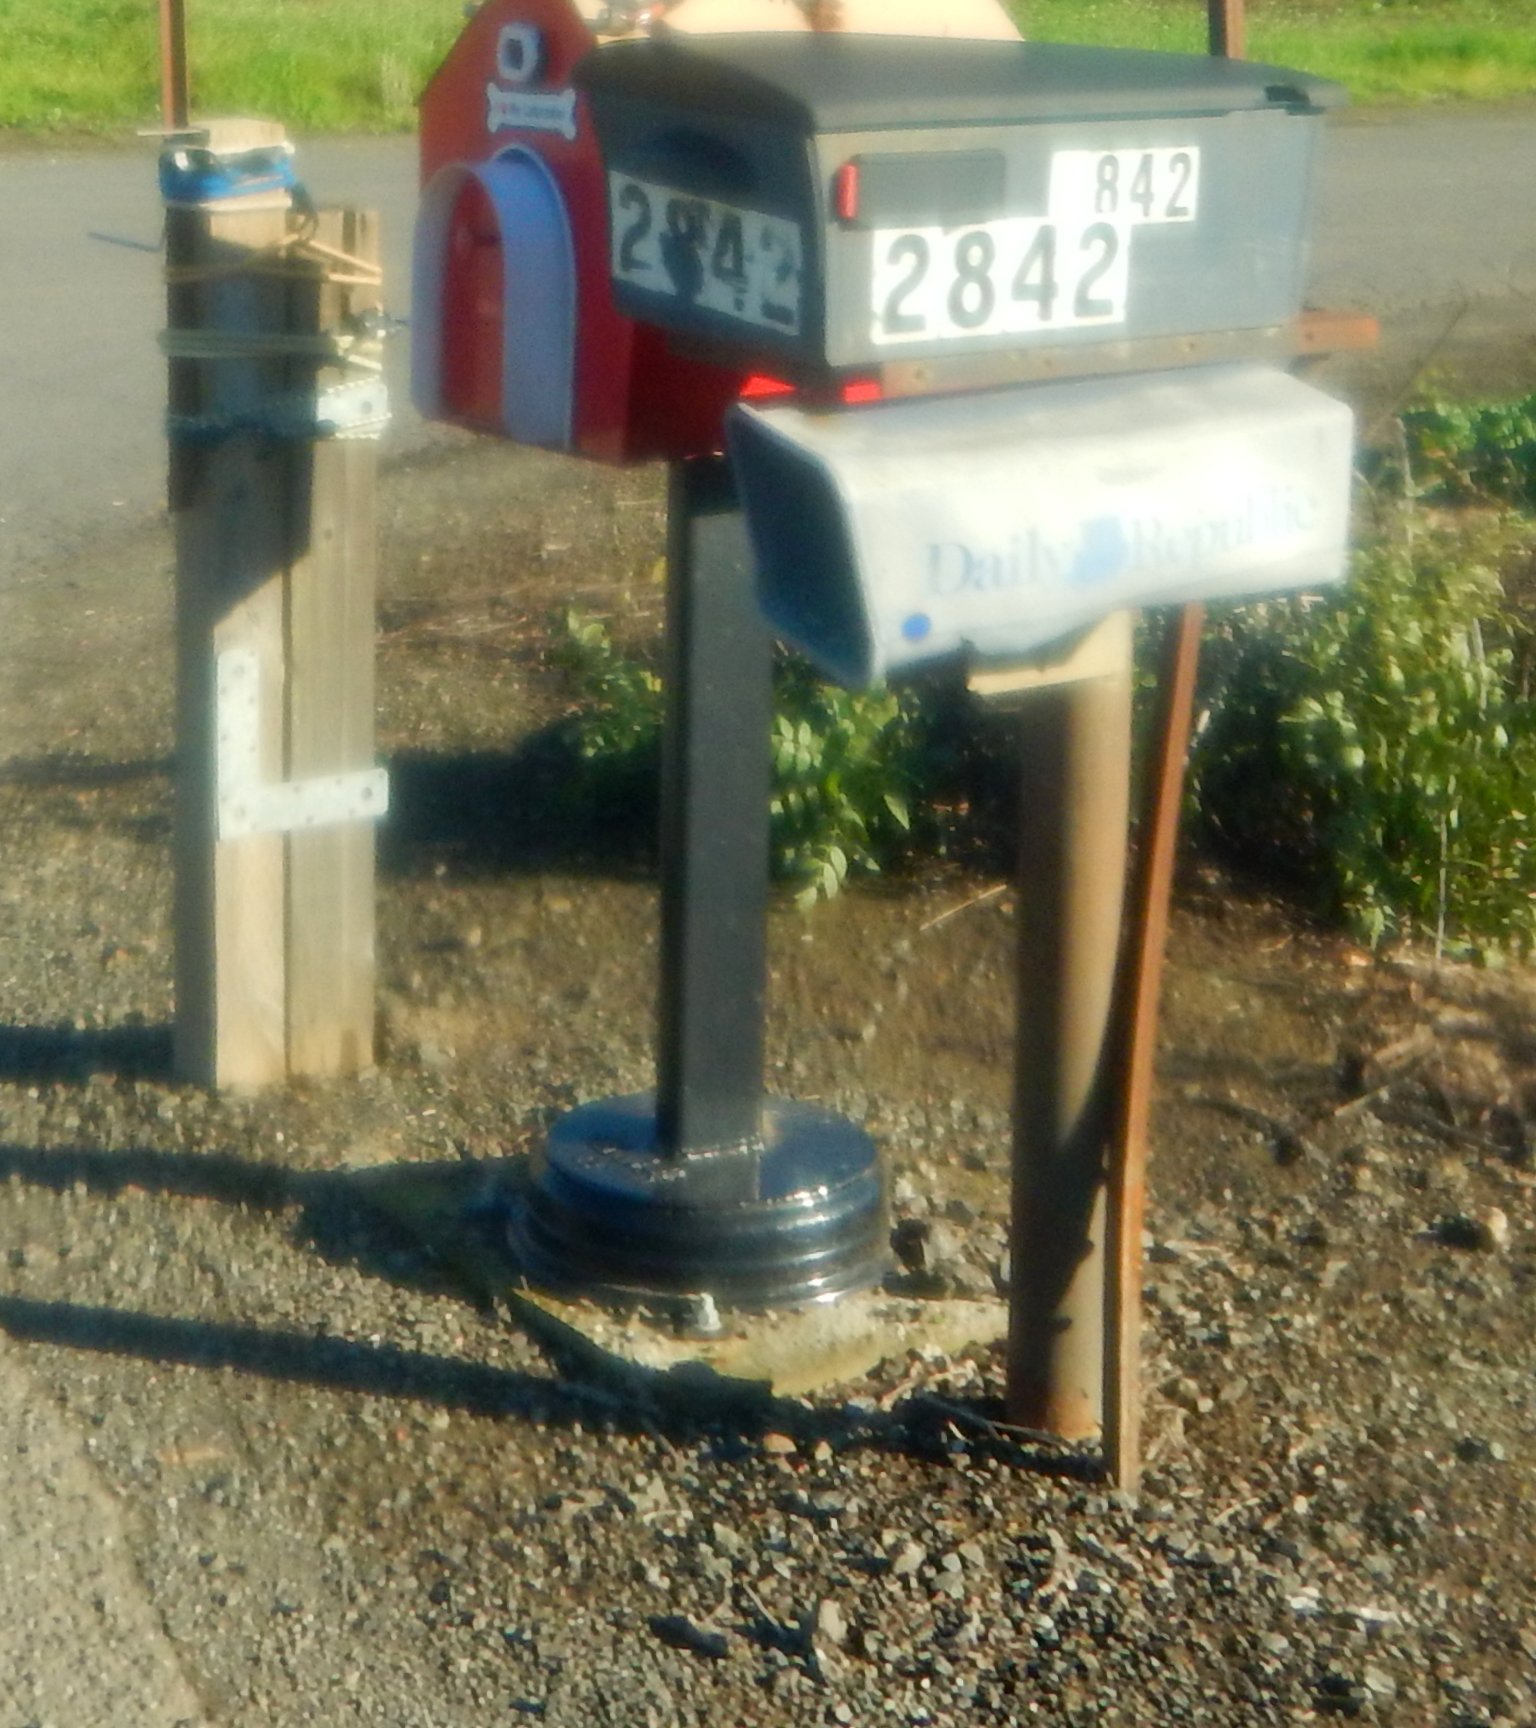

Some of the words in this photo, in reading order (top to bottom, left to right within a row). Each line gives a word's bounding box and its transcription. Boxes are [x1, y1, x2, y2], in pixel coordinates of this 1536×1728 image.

[1095, 150, 1194, 220] 842
[884, 223, 1120, 334] 2842
[925, 524, 1074, 597] Daily
